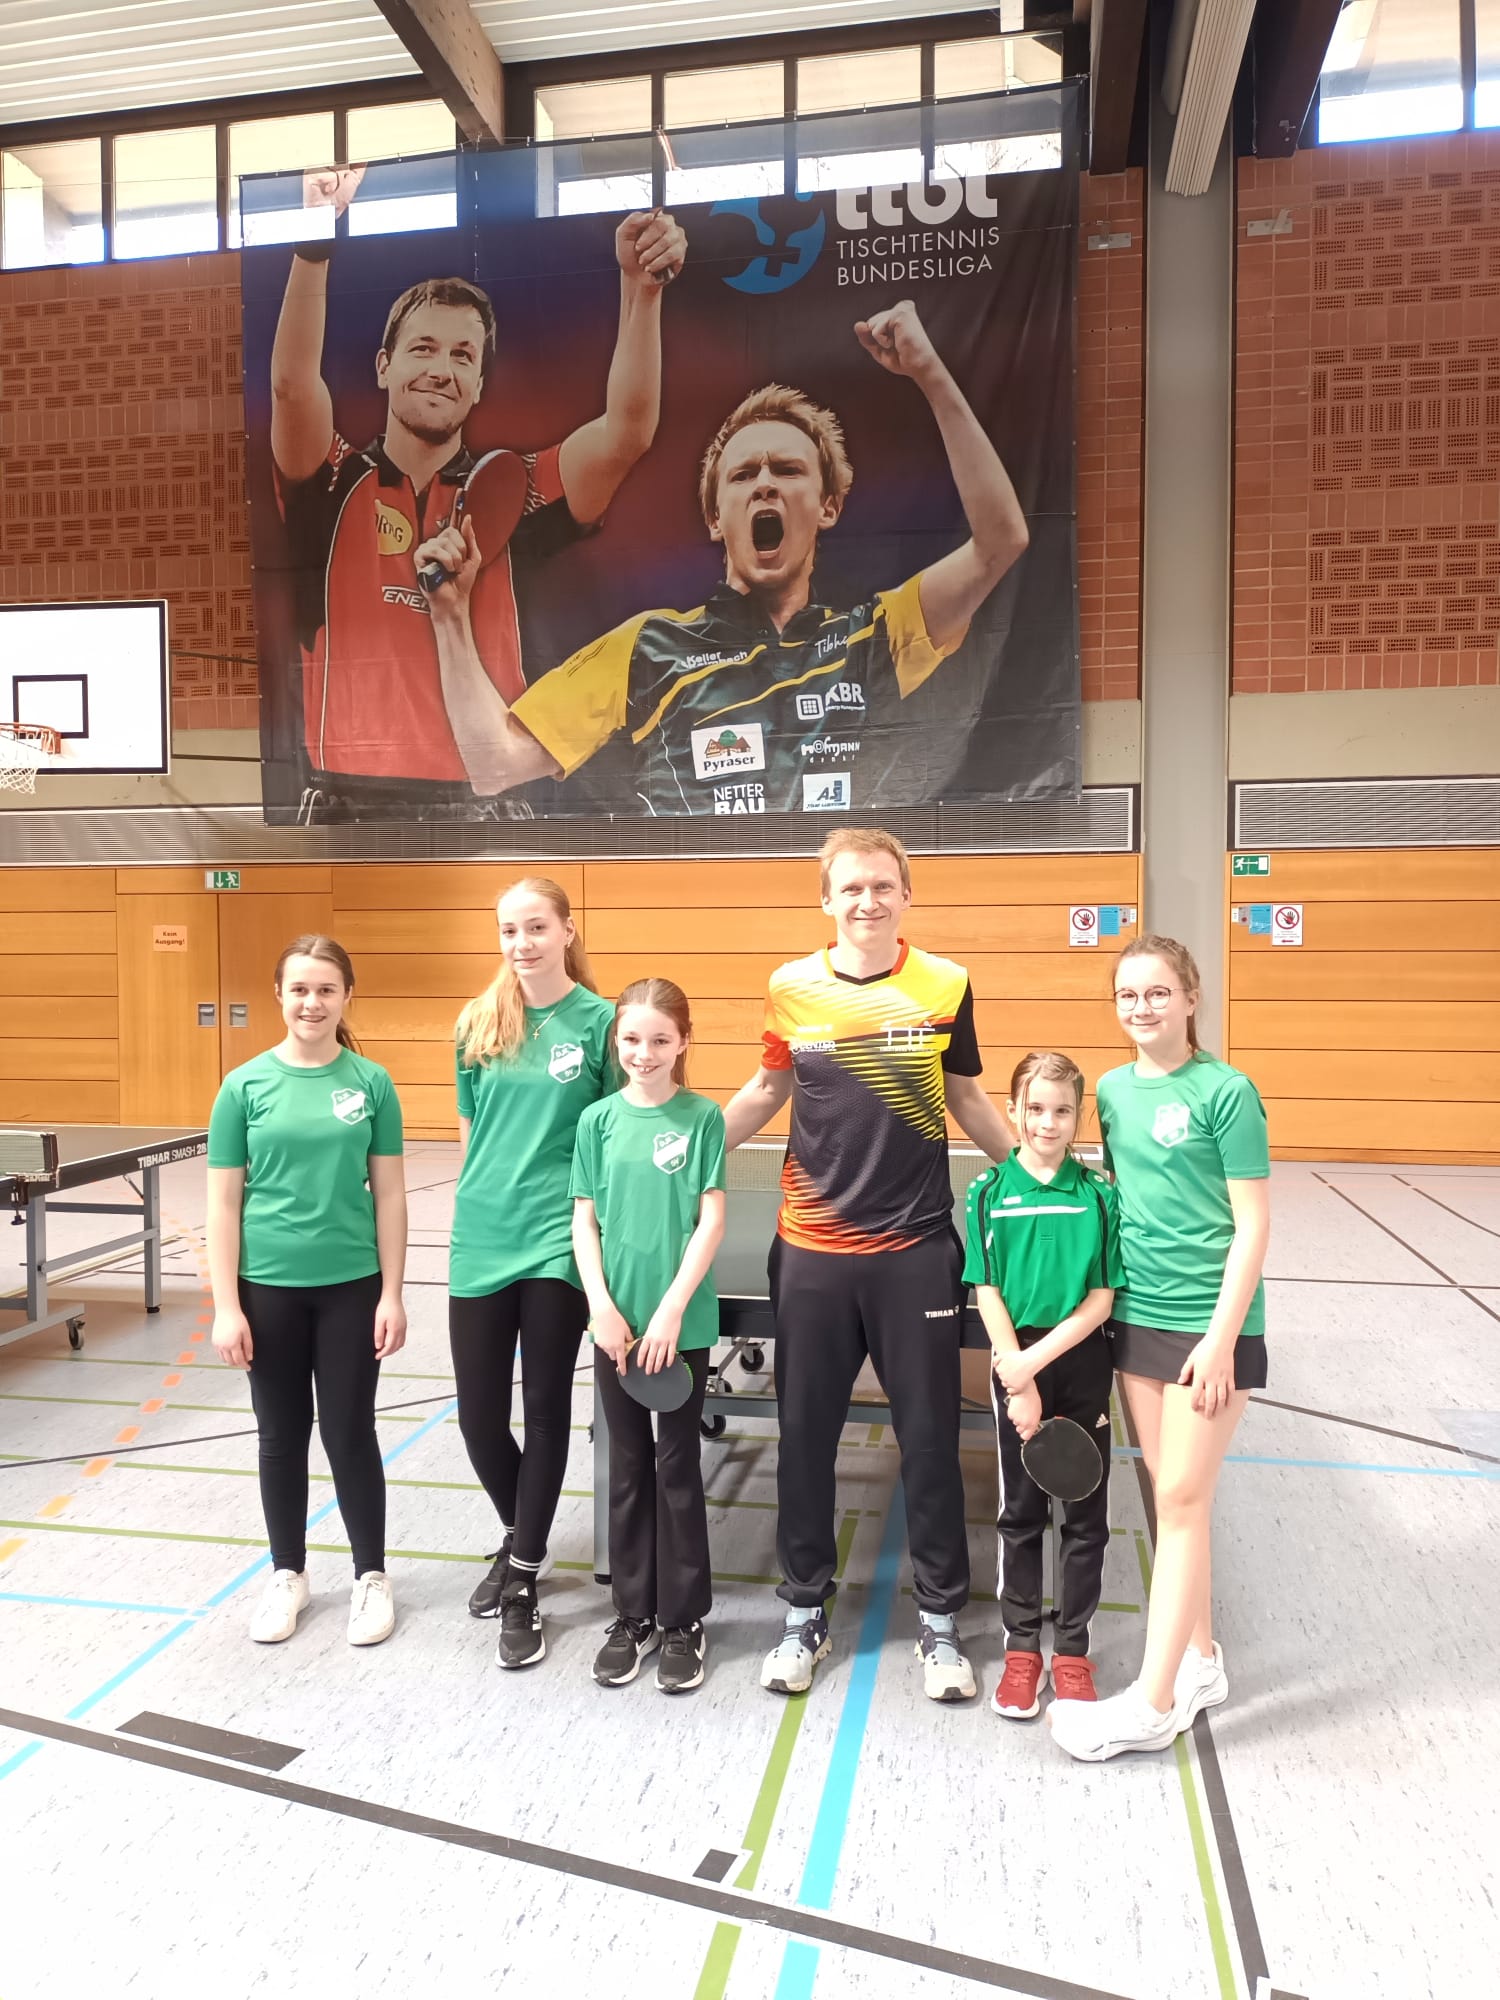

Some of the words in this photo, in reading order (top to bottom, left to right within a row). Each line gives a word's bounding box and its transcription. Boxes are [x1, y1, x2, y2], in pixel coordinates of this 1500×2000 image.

[836, 226, 1000, 260] TISCHTENNIS
[837, 254, 993, 286] BUNDESLIGA
[383, 590, 430, 609] ENE
[825, 682, 865, 706] KBR
[703, 756, 756, 772] Pyraser
[713, 783, 765, 802] NETTER
[714, 797, 765, 815] BAU
[137, 1150, 170, 1168] TIBHAR
[171, 1145, 196, 1161] SMASH
[924, 1309, 955, 1319] TIBHAR
